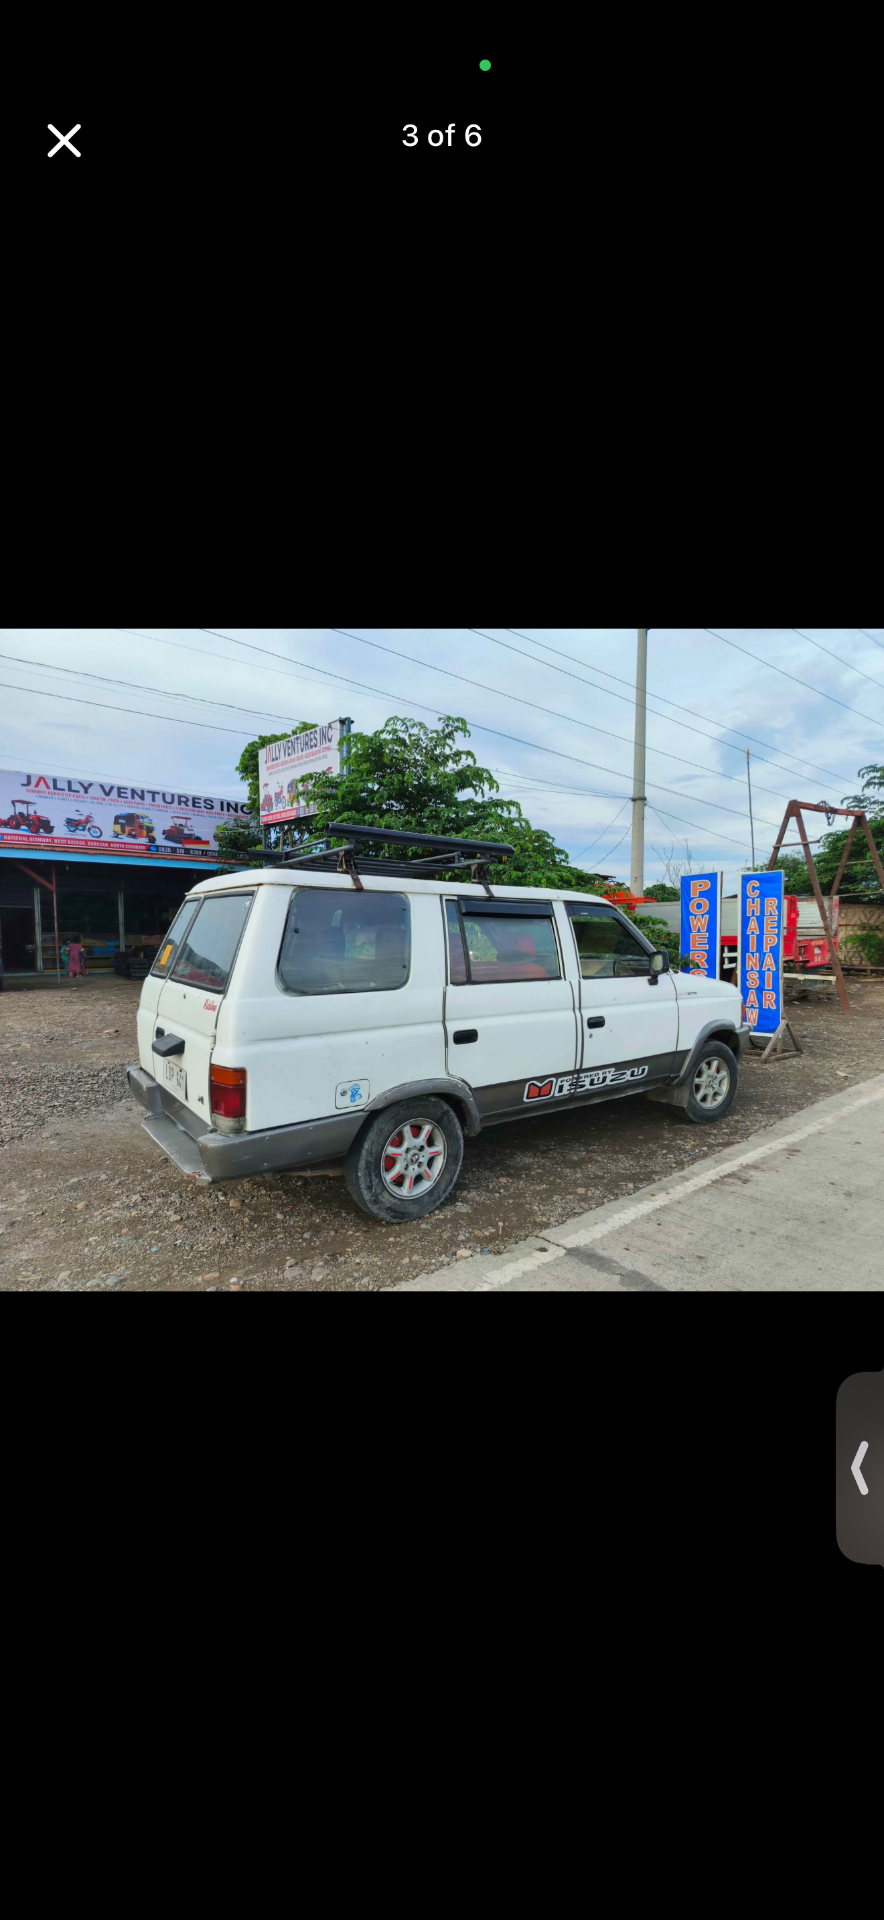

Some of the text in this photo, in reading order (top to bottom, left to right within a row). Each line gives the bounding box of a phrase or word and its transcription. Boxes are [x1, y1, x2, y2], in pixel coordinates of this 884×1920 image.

[265, 741, 282, 764] JALLY
[283, 730, 318, 757] VENTURES
[320, 723, 333, 745] INC
[21, 775, 93, 794] JALLY
[99, 784, 214, 810] VENTURES
[221, 801, 253, 815] INC
[746, 880, 760, 1026] CHAINSAW
[762, 898, 778, 1009] REPAIR
[555, 1066, 648, 1095] ISUZU
[560, 1072, 600, 1084] POWERED
